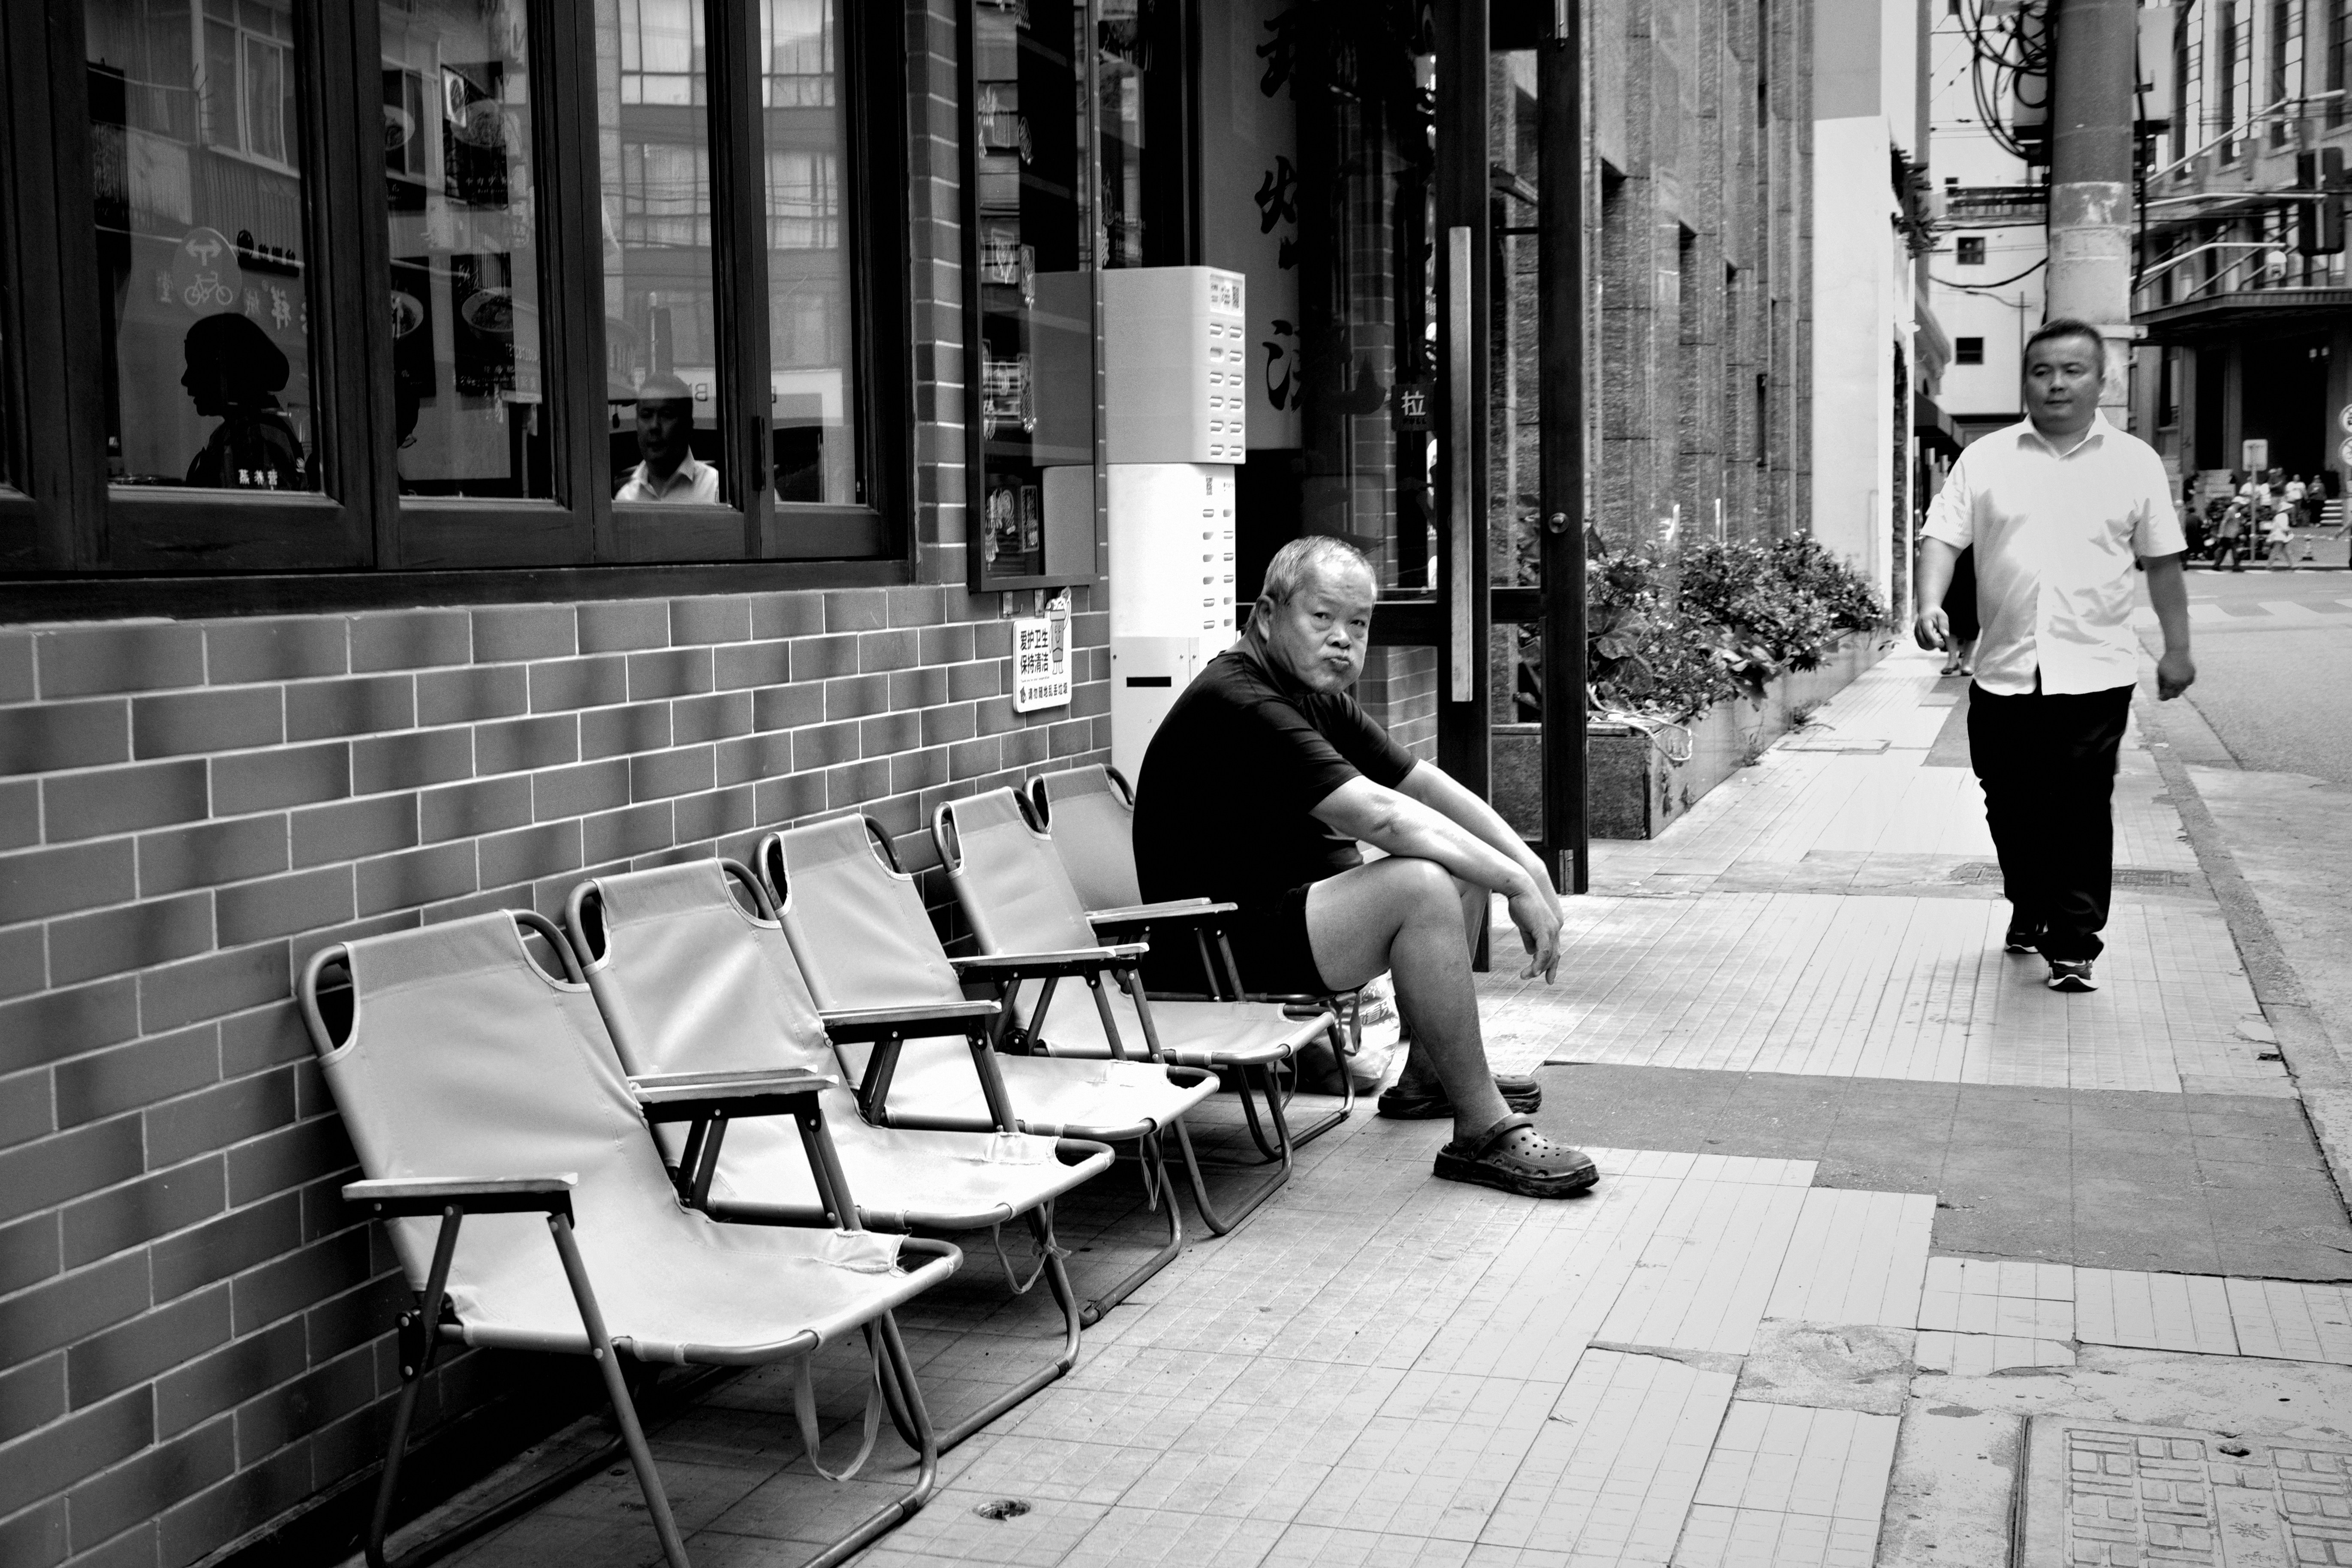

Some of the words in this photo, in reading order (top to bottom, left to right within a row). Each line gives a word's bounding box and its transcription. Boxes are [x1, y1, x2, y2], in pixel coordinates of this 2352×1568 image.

[1400, 390, 1427, 416] 拉
[1021, 628, 1048, 651] 爱护卫生
[1021, 651, 1049, 675] 保持清洁
